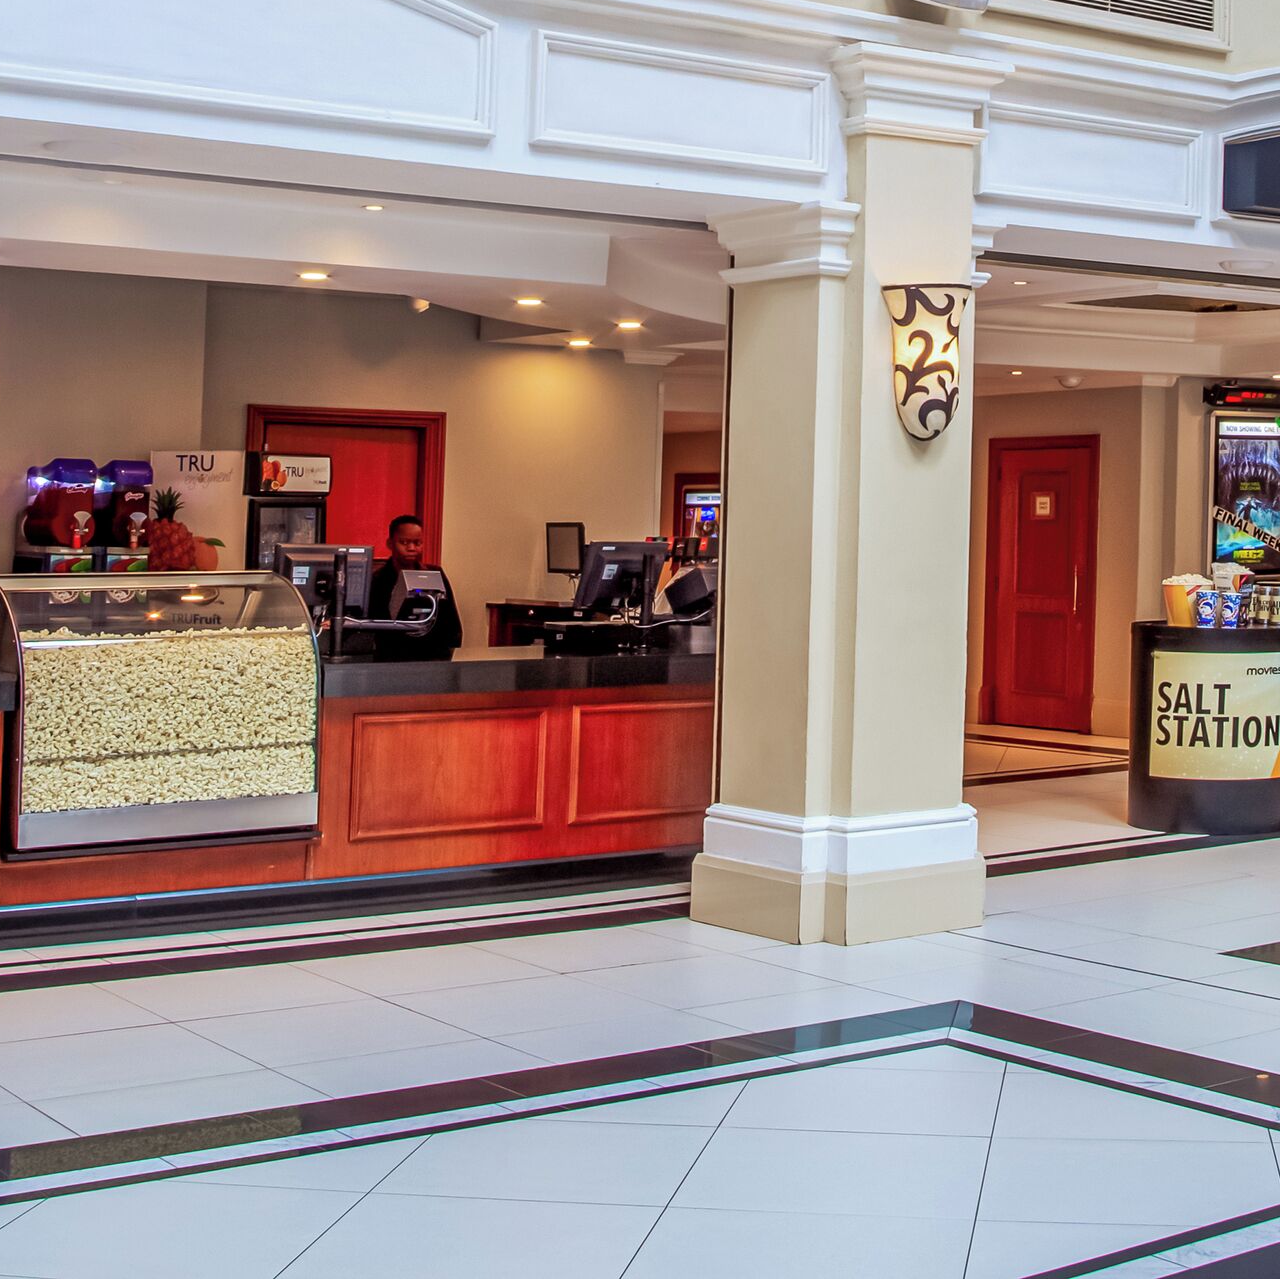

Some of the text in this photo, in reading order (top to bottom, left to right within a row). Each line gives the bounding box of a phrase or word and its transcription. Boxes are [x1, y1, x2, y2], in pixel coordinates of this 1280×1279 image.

[176, 454, 215, 472] TRU
[285, 466, 304, 478] TRU
[1215, 508, 1248, 533] FINAL
[1157, 681, 1231, 715] SALT
[1155, 714, 1280, 748] STATION
